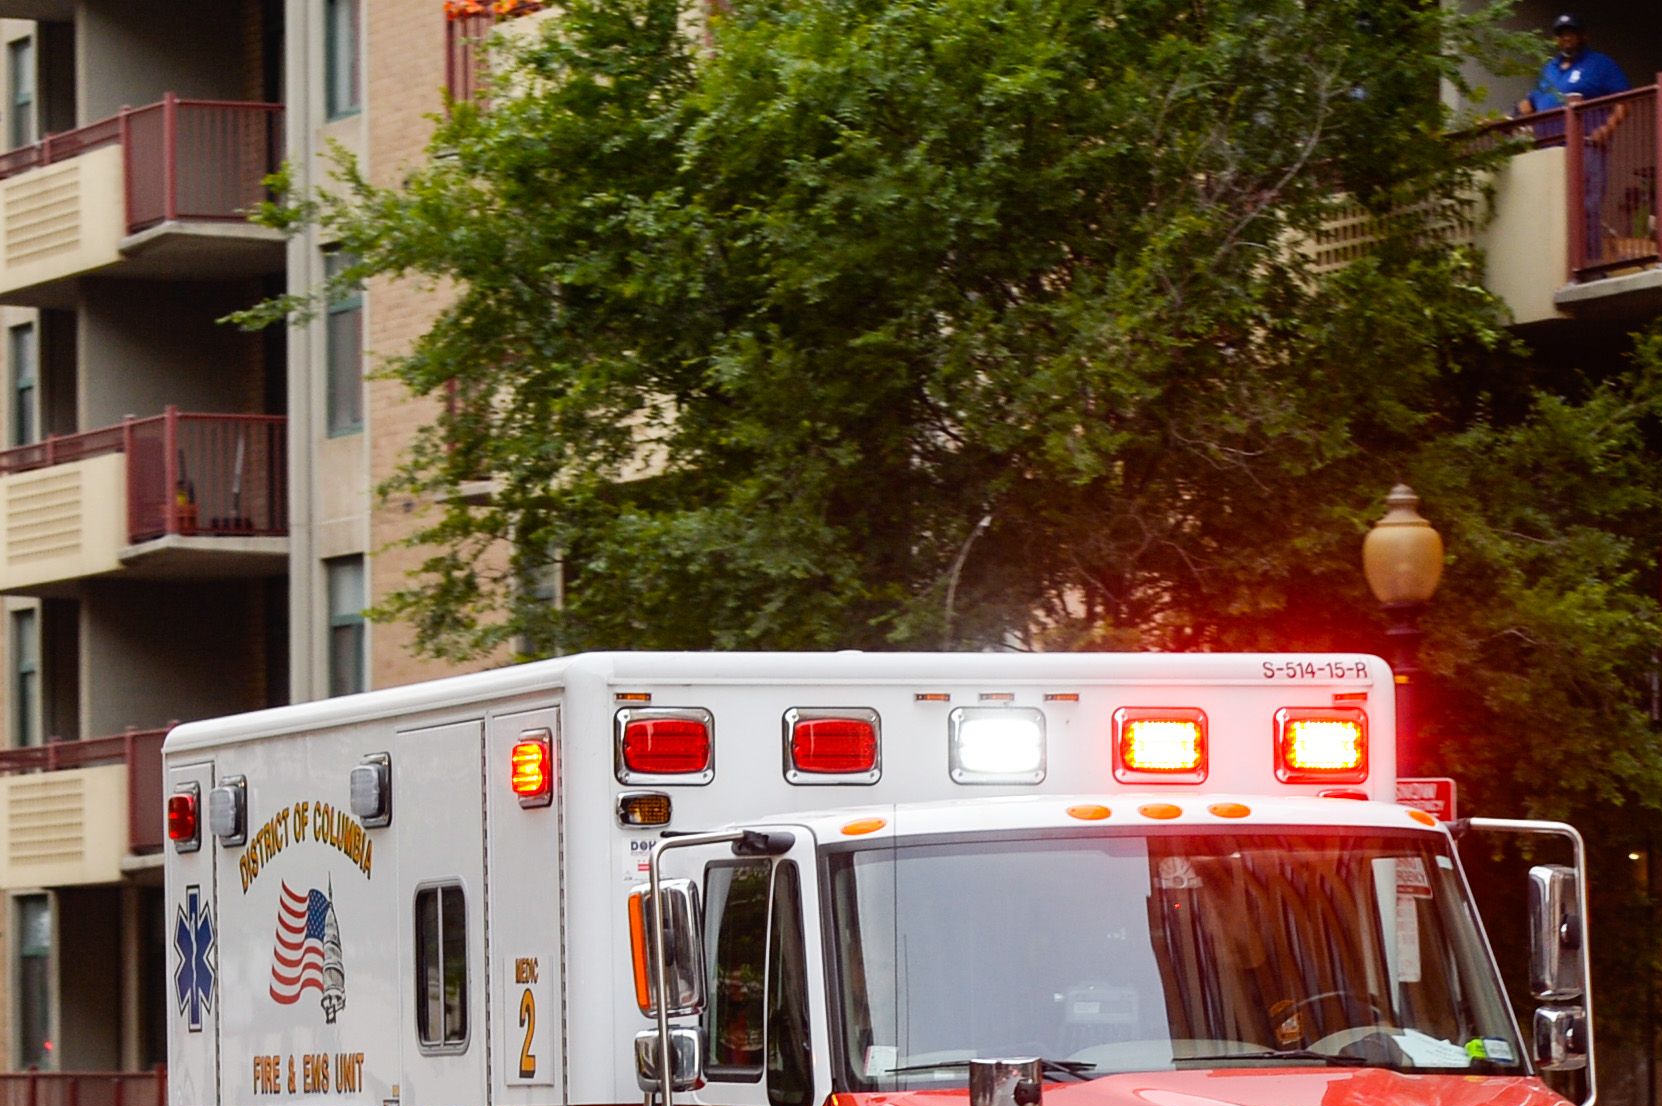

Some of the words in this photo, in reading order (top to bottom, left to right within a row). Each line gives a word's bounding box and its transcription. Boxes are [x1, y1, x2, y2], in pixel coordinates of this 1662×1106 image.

[1262, 661, 1368, 679] S-514-15-R
[239, 807, 289, 895] DISTRICT
[293, 801, 309, 843] OF
[313, 801, 373, 881] COLUMBIA
[515, 957, 539, 984] MEDIC
[519, 987, 536, 1079] 2
[253, 1056, 281, 1095] FIRE
[287, 1054, 297, 1095] &
[303, 1053, 330, 1094] EMS
[335, 1052, 365, 1094] UNIT
